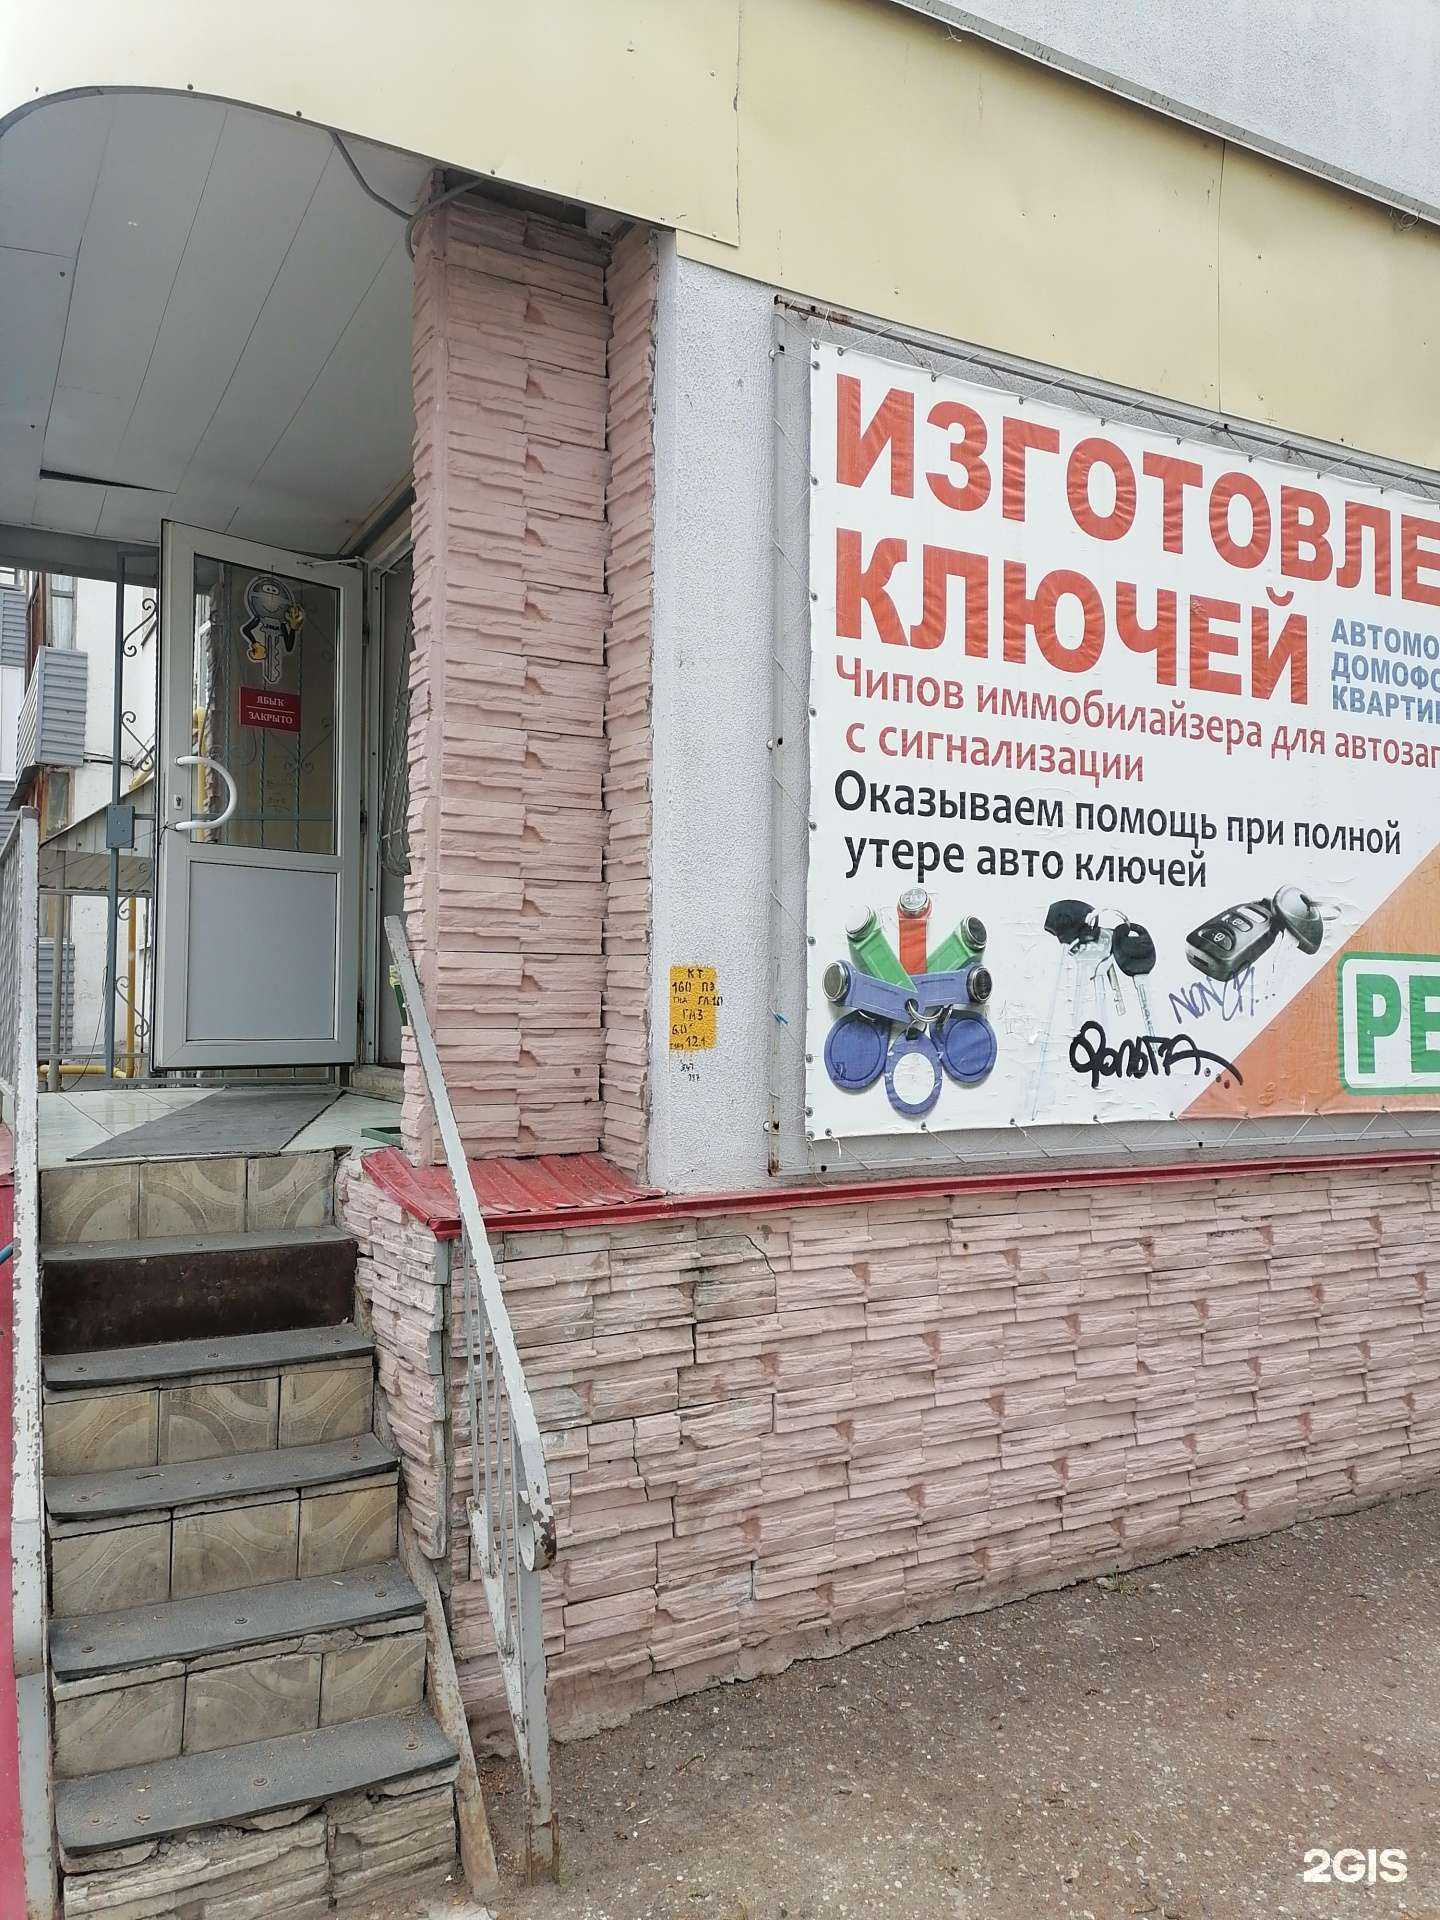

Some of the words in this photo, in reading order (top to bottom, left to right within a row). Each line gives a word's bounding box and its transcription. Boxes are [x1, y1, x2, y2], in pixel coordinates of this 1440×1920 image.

[836, 528, 1307, 705] КЛЮЧЕЙ
[248, 711, 293, 725] ЗАКРЫТО
[837, 655, 964, 710] Чипов
[977, 684, 1262, 756] иммобилайзера
[1271, 725, 1326, 761] для
[1332, 685, 1440, 726] КВАРТИ
[846, 722, 866, 753] с
[878, 727, 1144, 789] сигнализации
[835, 769, 1063, 828] Оказываем
[1075, 802, 1218, 850] помощь
[1227, 816, 1284, 855] при
[1293, 819, 1401, 855] полной
[845, 834, 965, 883] утере
[976, 842, 1064, 880] авто
[1075, 850, 1206, 888] ключей
[1356, 973, 1440, 1074] РЕ
